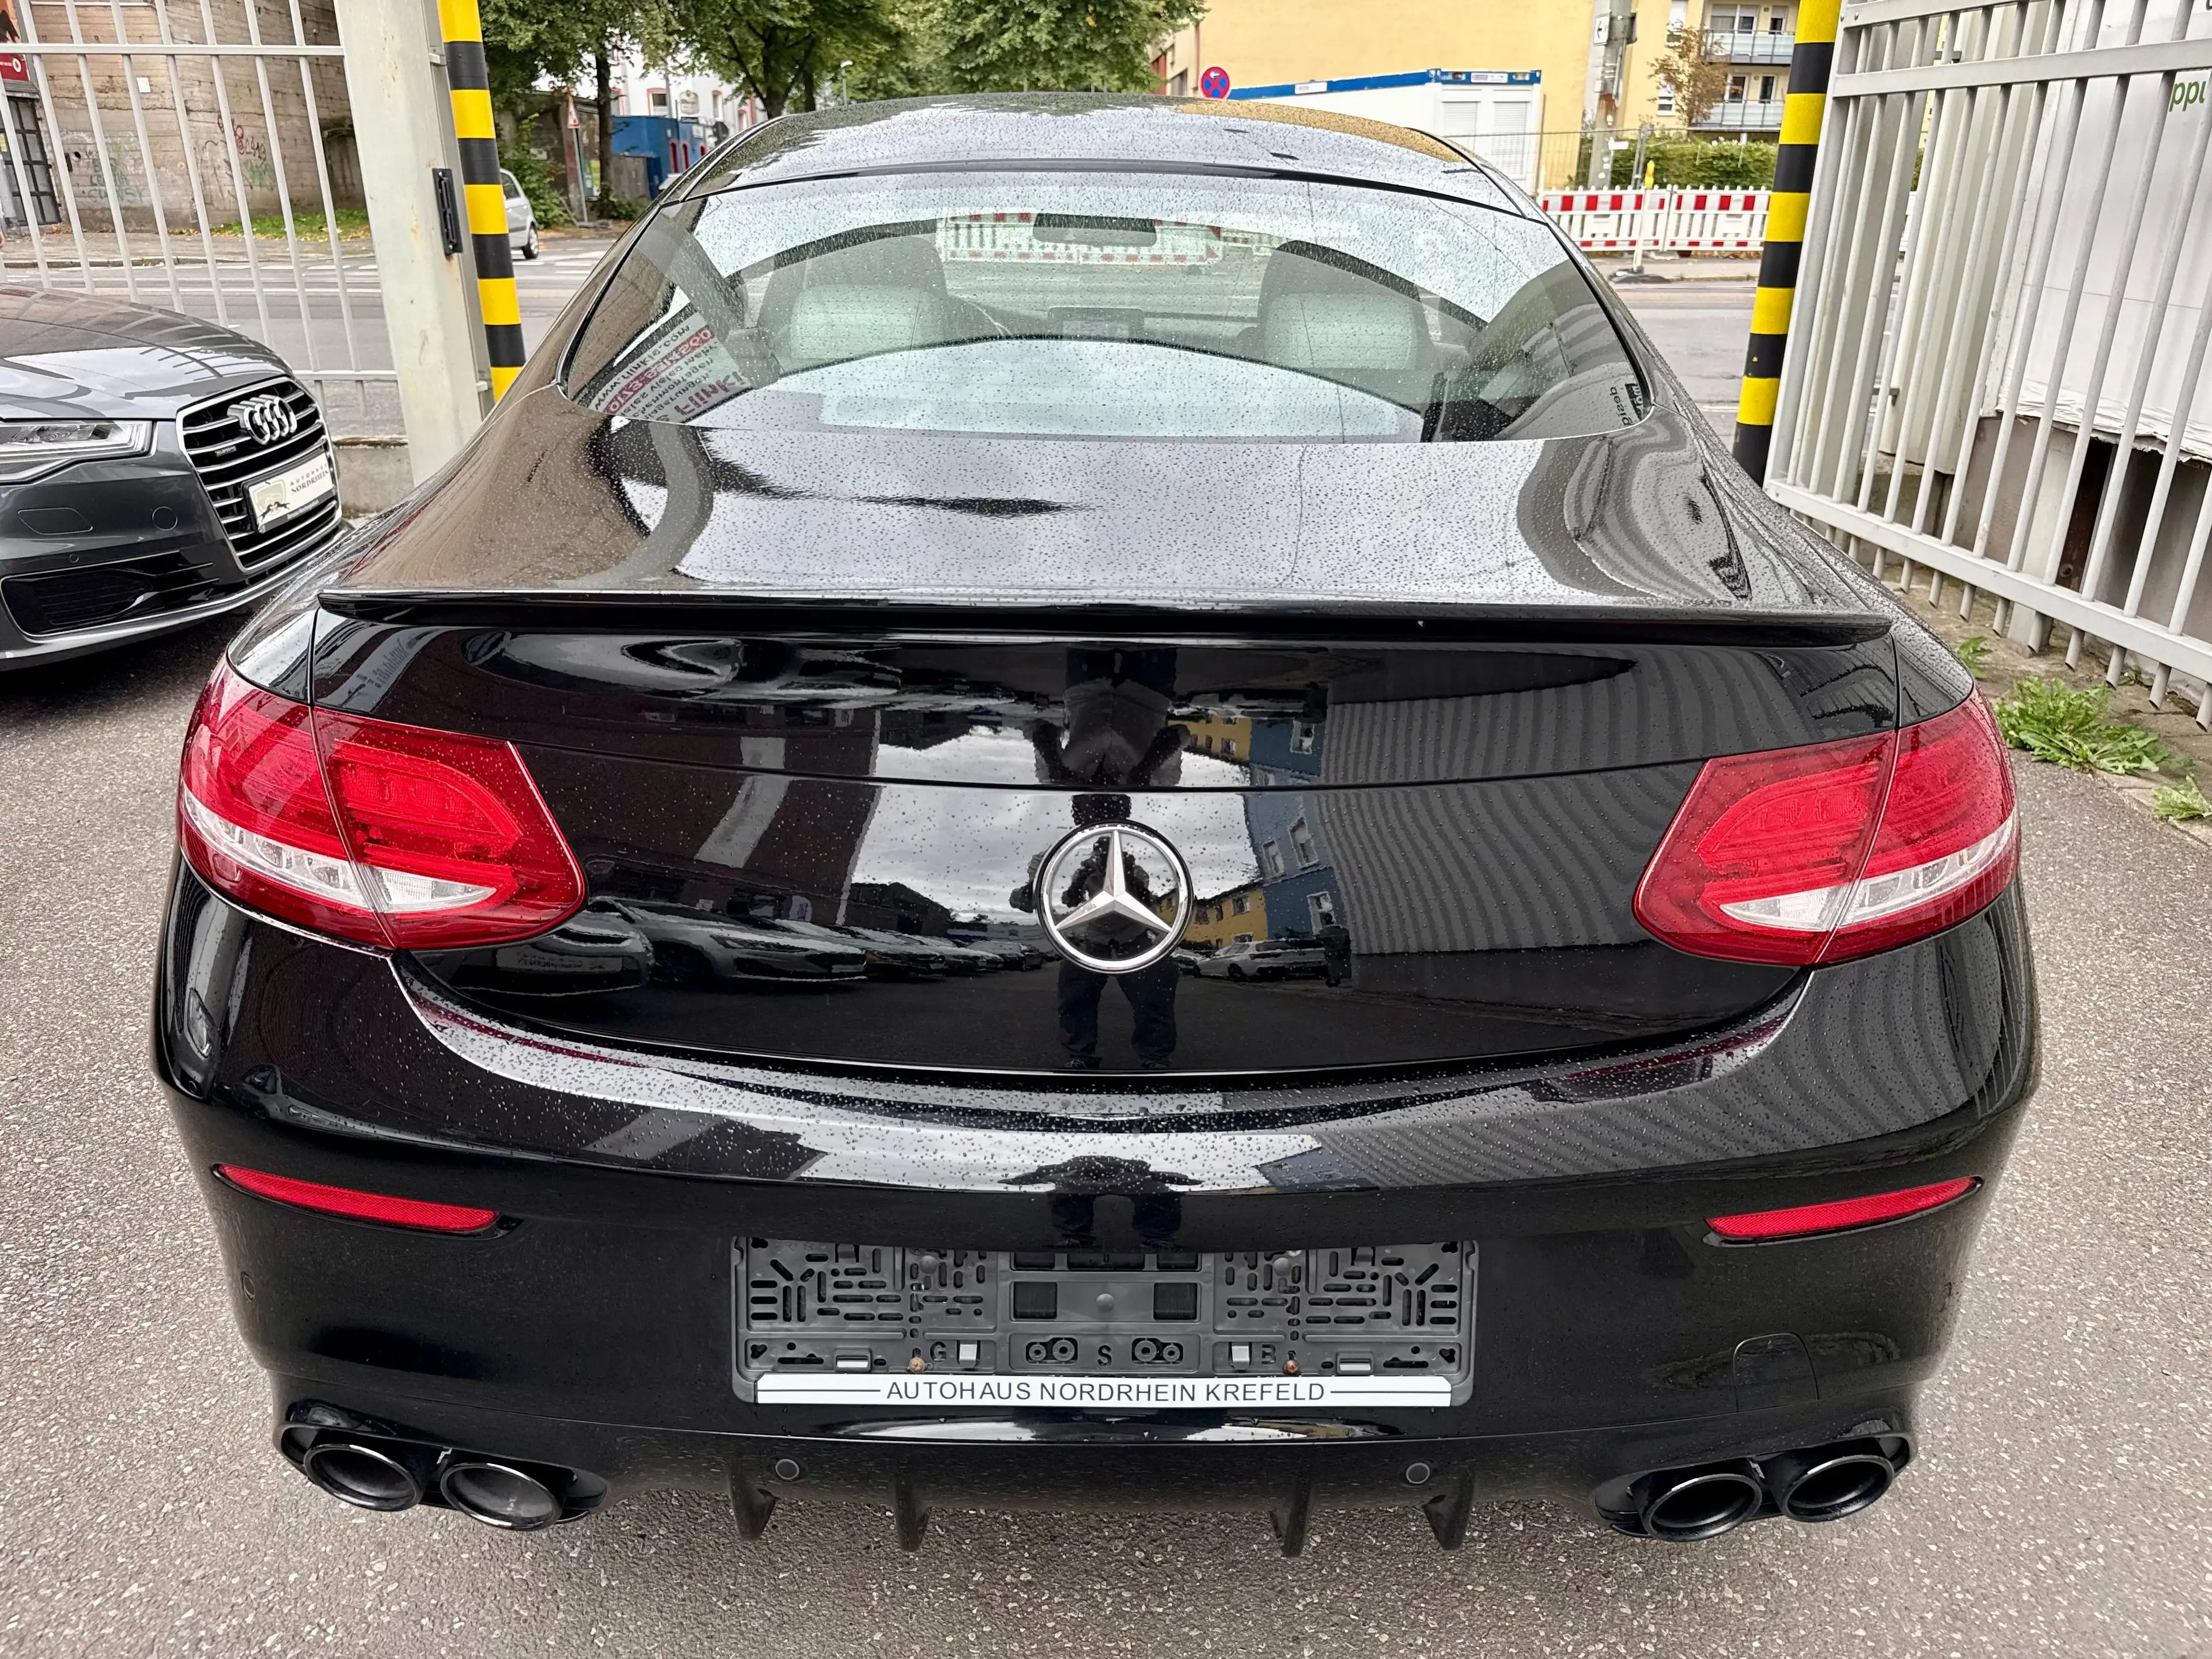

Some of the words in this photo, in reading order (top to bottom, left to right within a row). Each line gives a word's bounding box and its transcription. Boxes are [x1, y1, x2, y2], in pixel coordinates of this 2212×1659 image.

[1097, 1344, 1113, 1366] S
[886, 1382, 1031, 1400] AUTOHAUS
[1040, 1382, 1197, 1401] NORDRHEIN
[1206, 1383, 1325, 1401] KREFELD
